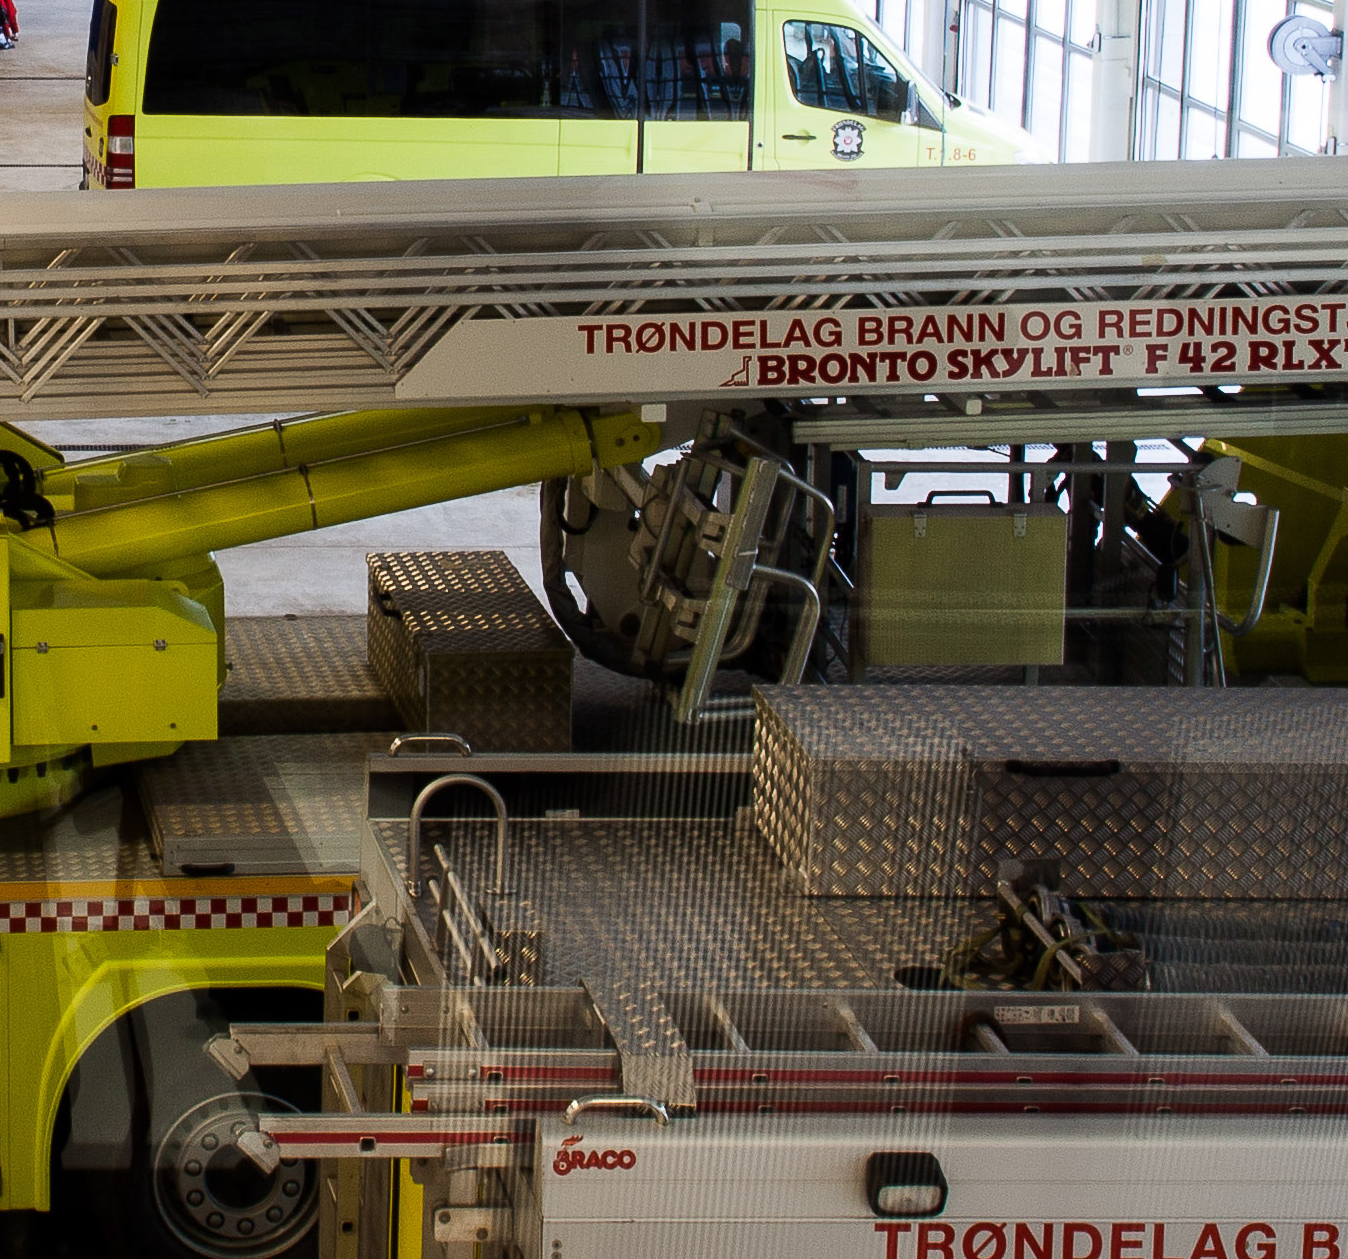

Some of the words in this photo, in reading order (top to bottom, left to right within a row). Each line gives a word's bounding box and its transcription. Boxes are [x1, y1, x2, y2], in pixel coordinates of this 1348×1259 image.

[926, 147, 977, 161] T..8-6
[577, 317, 844, 355] TRØNDELAG
[857, 312, 1006, 347] BRANN
[1019, 309, 1082, 342] OG
[757, 351, 938, 386] BRONTO
[1145, 343, 1169, 374] F
[1178, 340, 1237, 373] 42
[874, 1222, 1278, 1259] TRØNDELAG
